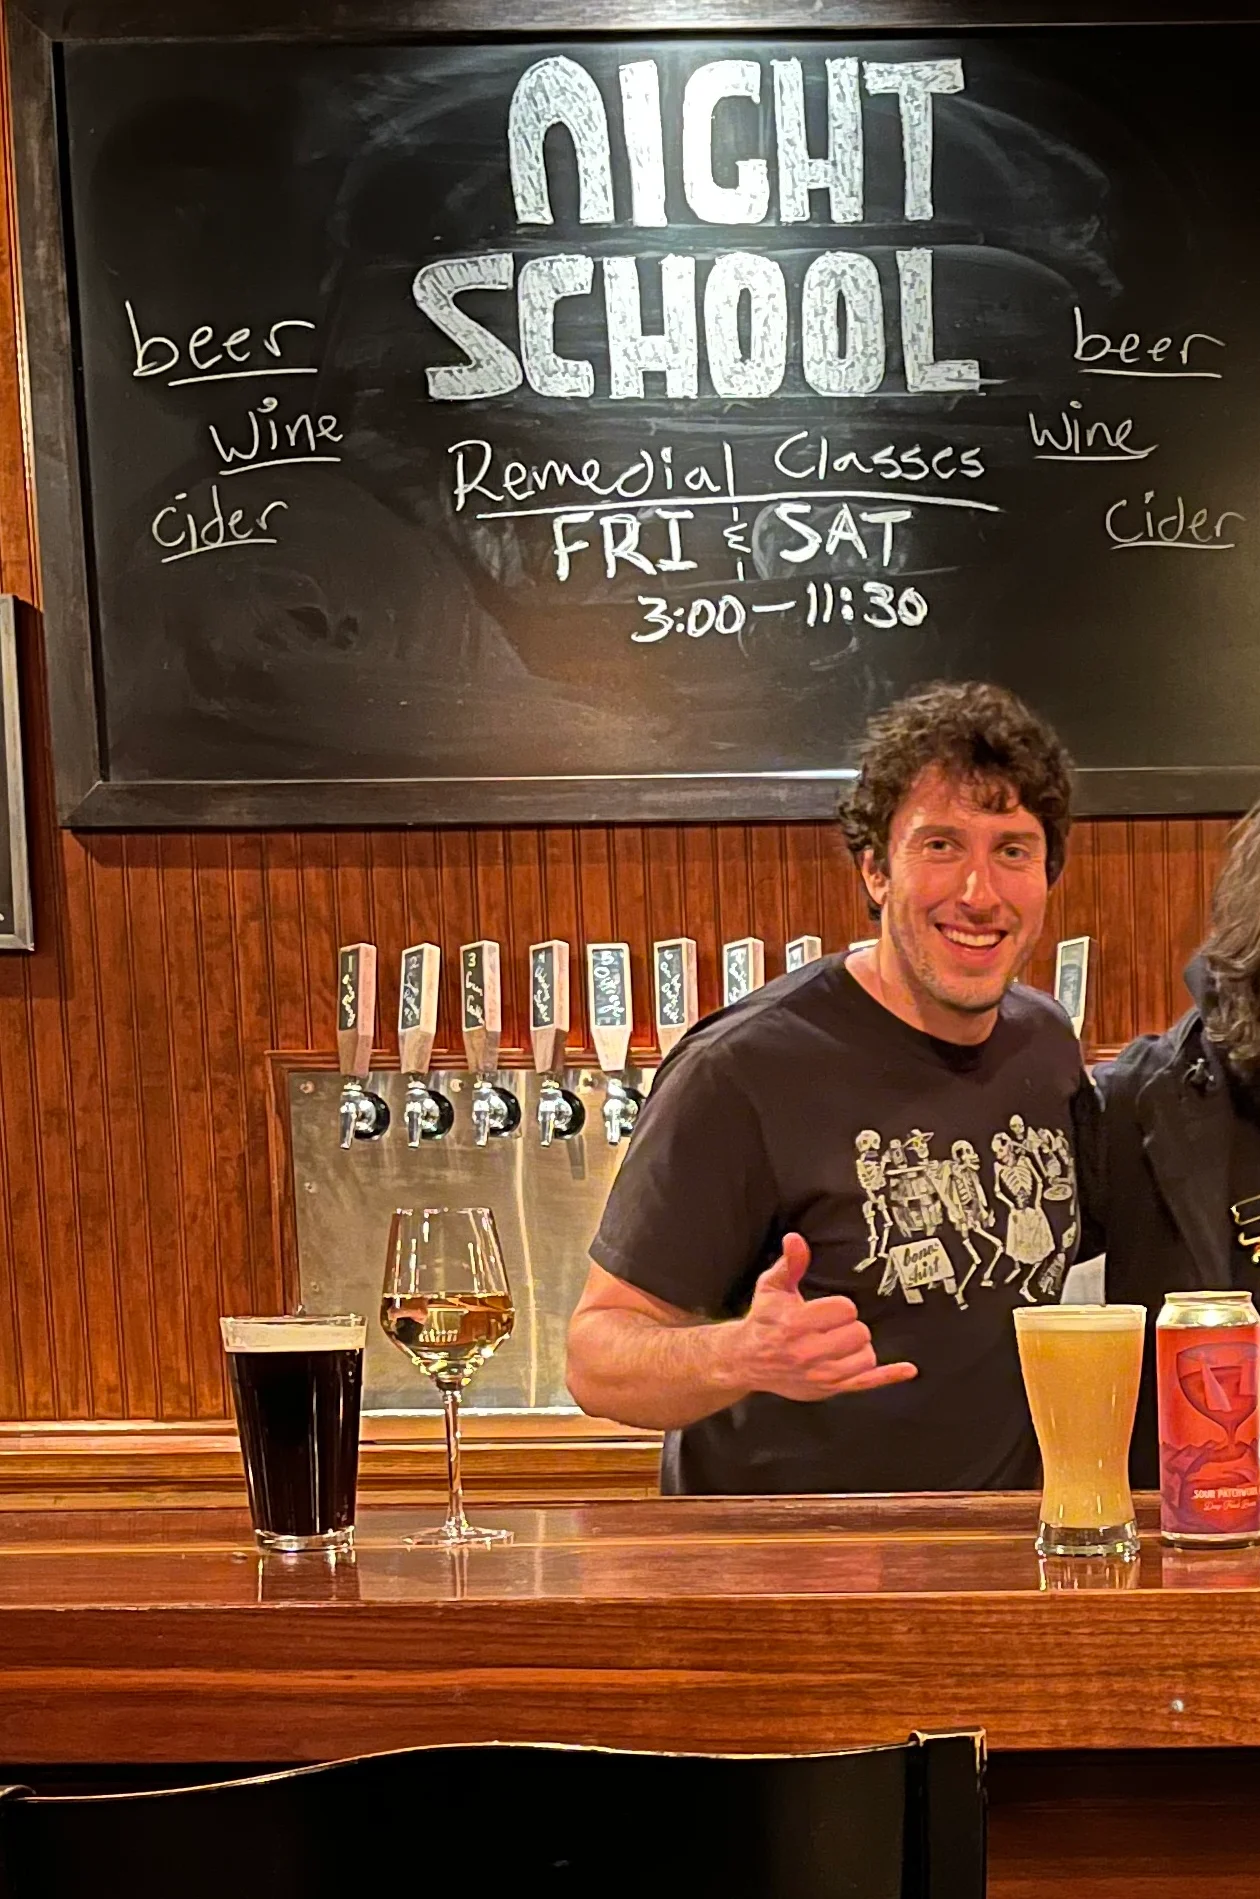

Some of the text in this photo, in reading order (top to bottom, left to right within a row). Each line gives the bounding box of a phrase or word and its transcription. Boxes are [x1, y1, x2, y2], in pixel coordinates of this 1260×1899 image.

[508, 56, 963, 226] NIGHT
[125, 300, 315, 377] beer
[413, 249, 979, 398] SCHOOL
[1074, 306, 1225, 364] beer
[448, 431, 985, 511] Remedial Classes
[551, 511, 698, 581] FRI
[776, 502, 914, 567] SAT
